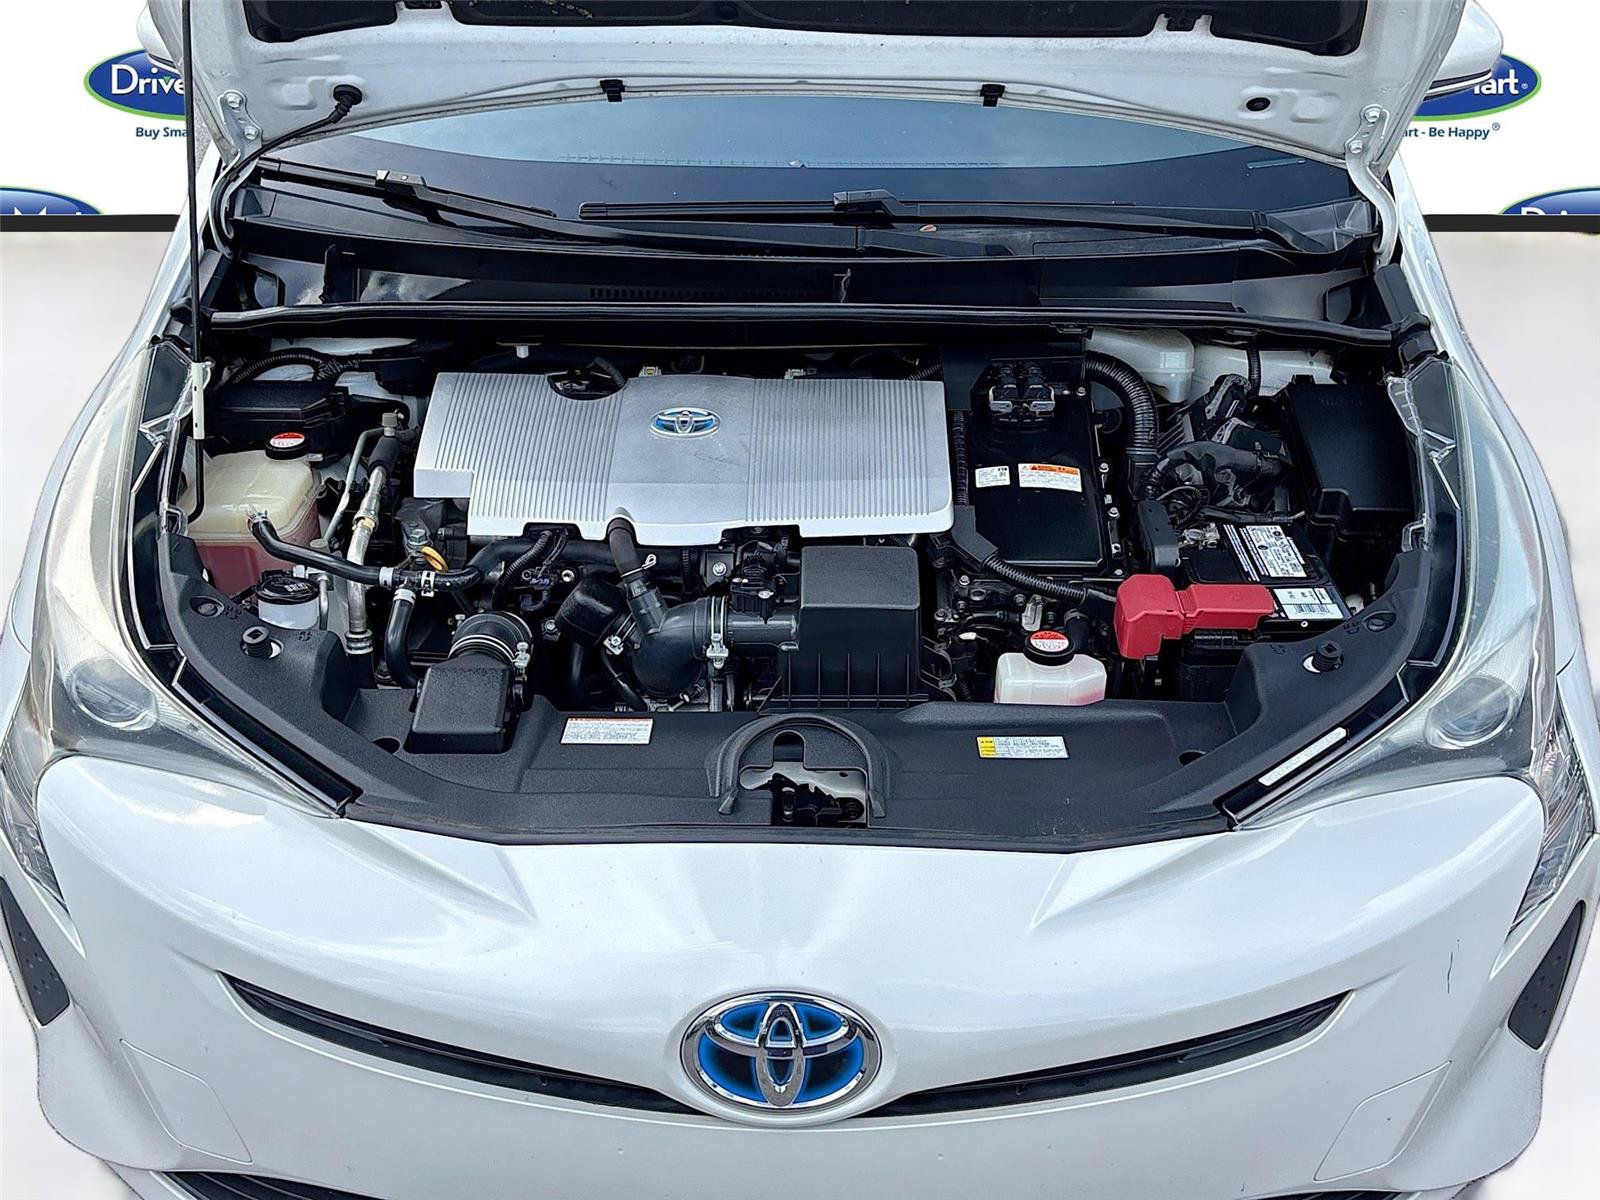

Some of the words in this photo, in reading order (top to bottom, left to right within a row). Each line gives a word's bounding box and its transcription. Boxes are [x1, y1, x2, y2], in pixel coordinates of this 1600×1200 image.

[135, 127, 160, 140] Buy
[1429, 127, 1445, 137] Be
[1448, 127, 1490, 140] Happy
